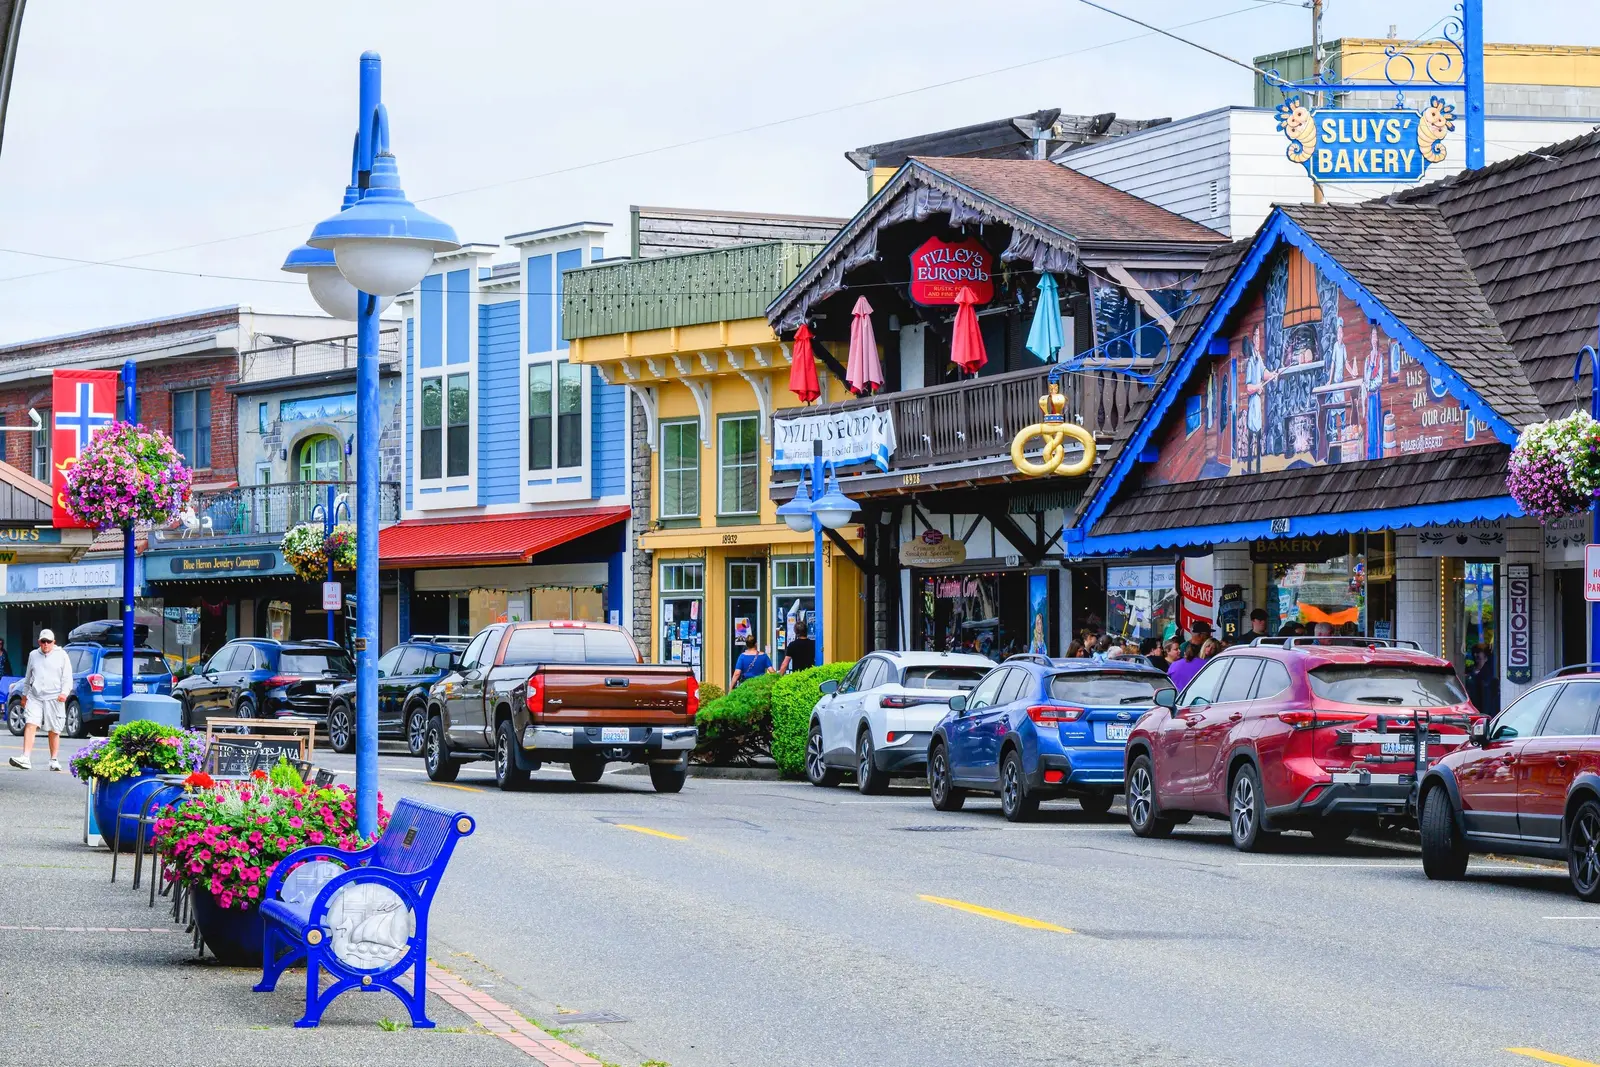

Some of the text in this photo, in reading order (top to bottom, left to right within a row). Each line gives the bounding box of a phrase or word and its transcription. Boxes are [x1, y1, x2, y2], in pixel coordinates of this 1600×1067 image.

[1321, 118, 1411, 144] SLUYS'
[1318, 149, 1416, 173] BAKERY
[920, 248, 983, 267] TIZLEY'S
[722, 534, 737, 544] 18932
[1256, 540, 1322, 552] BAKERY
[183, 556, 260, 570] Blue Heron Jewelry Company
[84, 566, 110, 584] books
[1510, 580, 1528, 666] SHOES
[635, 699, 684, 707] TUNDRA
